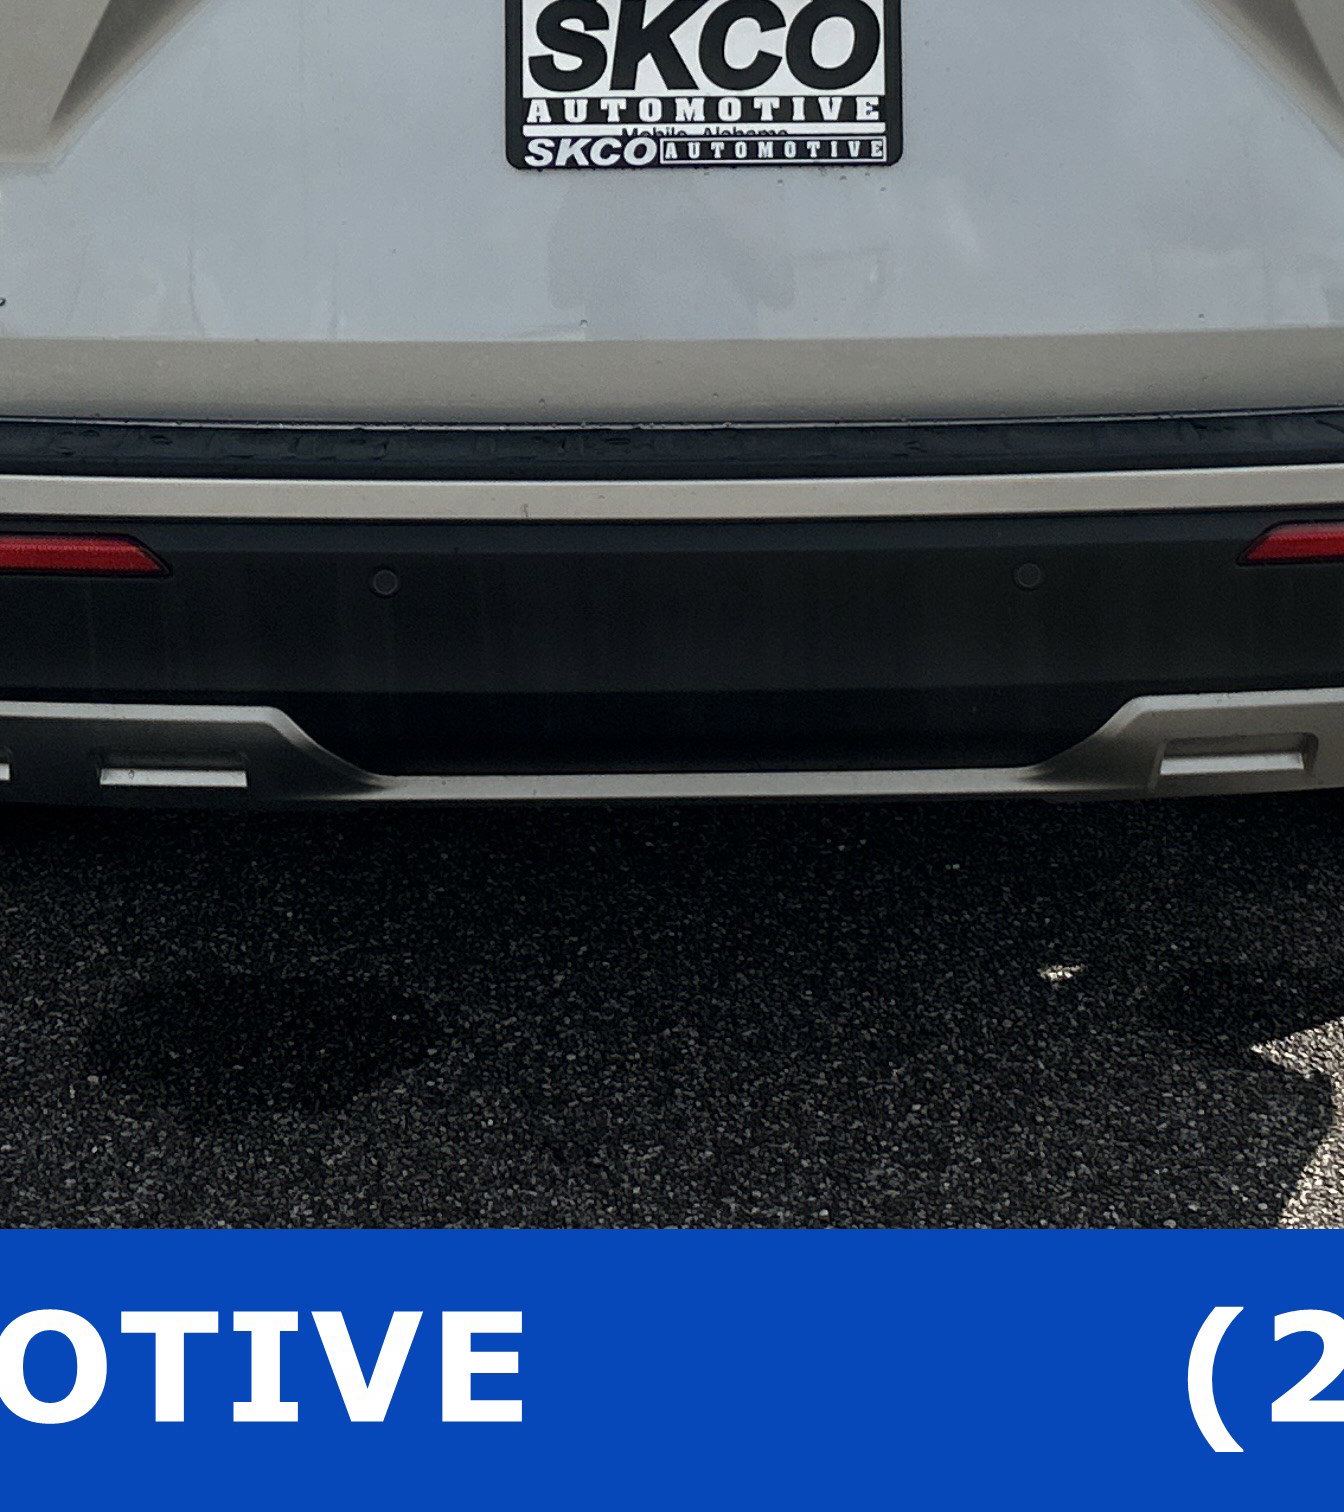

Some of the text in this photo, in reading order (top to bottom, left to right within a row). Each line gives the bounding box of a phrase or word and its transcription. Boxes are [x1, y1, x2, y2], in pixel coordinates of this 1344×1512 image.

[526, 97, 881, 123] AUTOMOTIVE
[524, 138, 884, 167] SKCO AUTOMOTIVE
